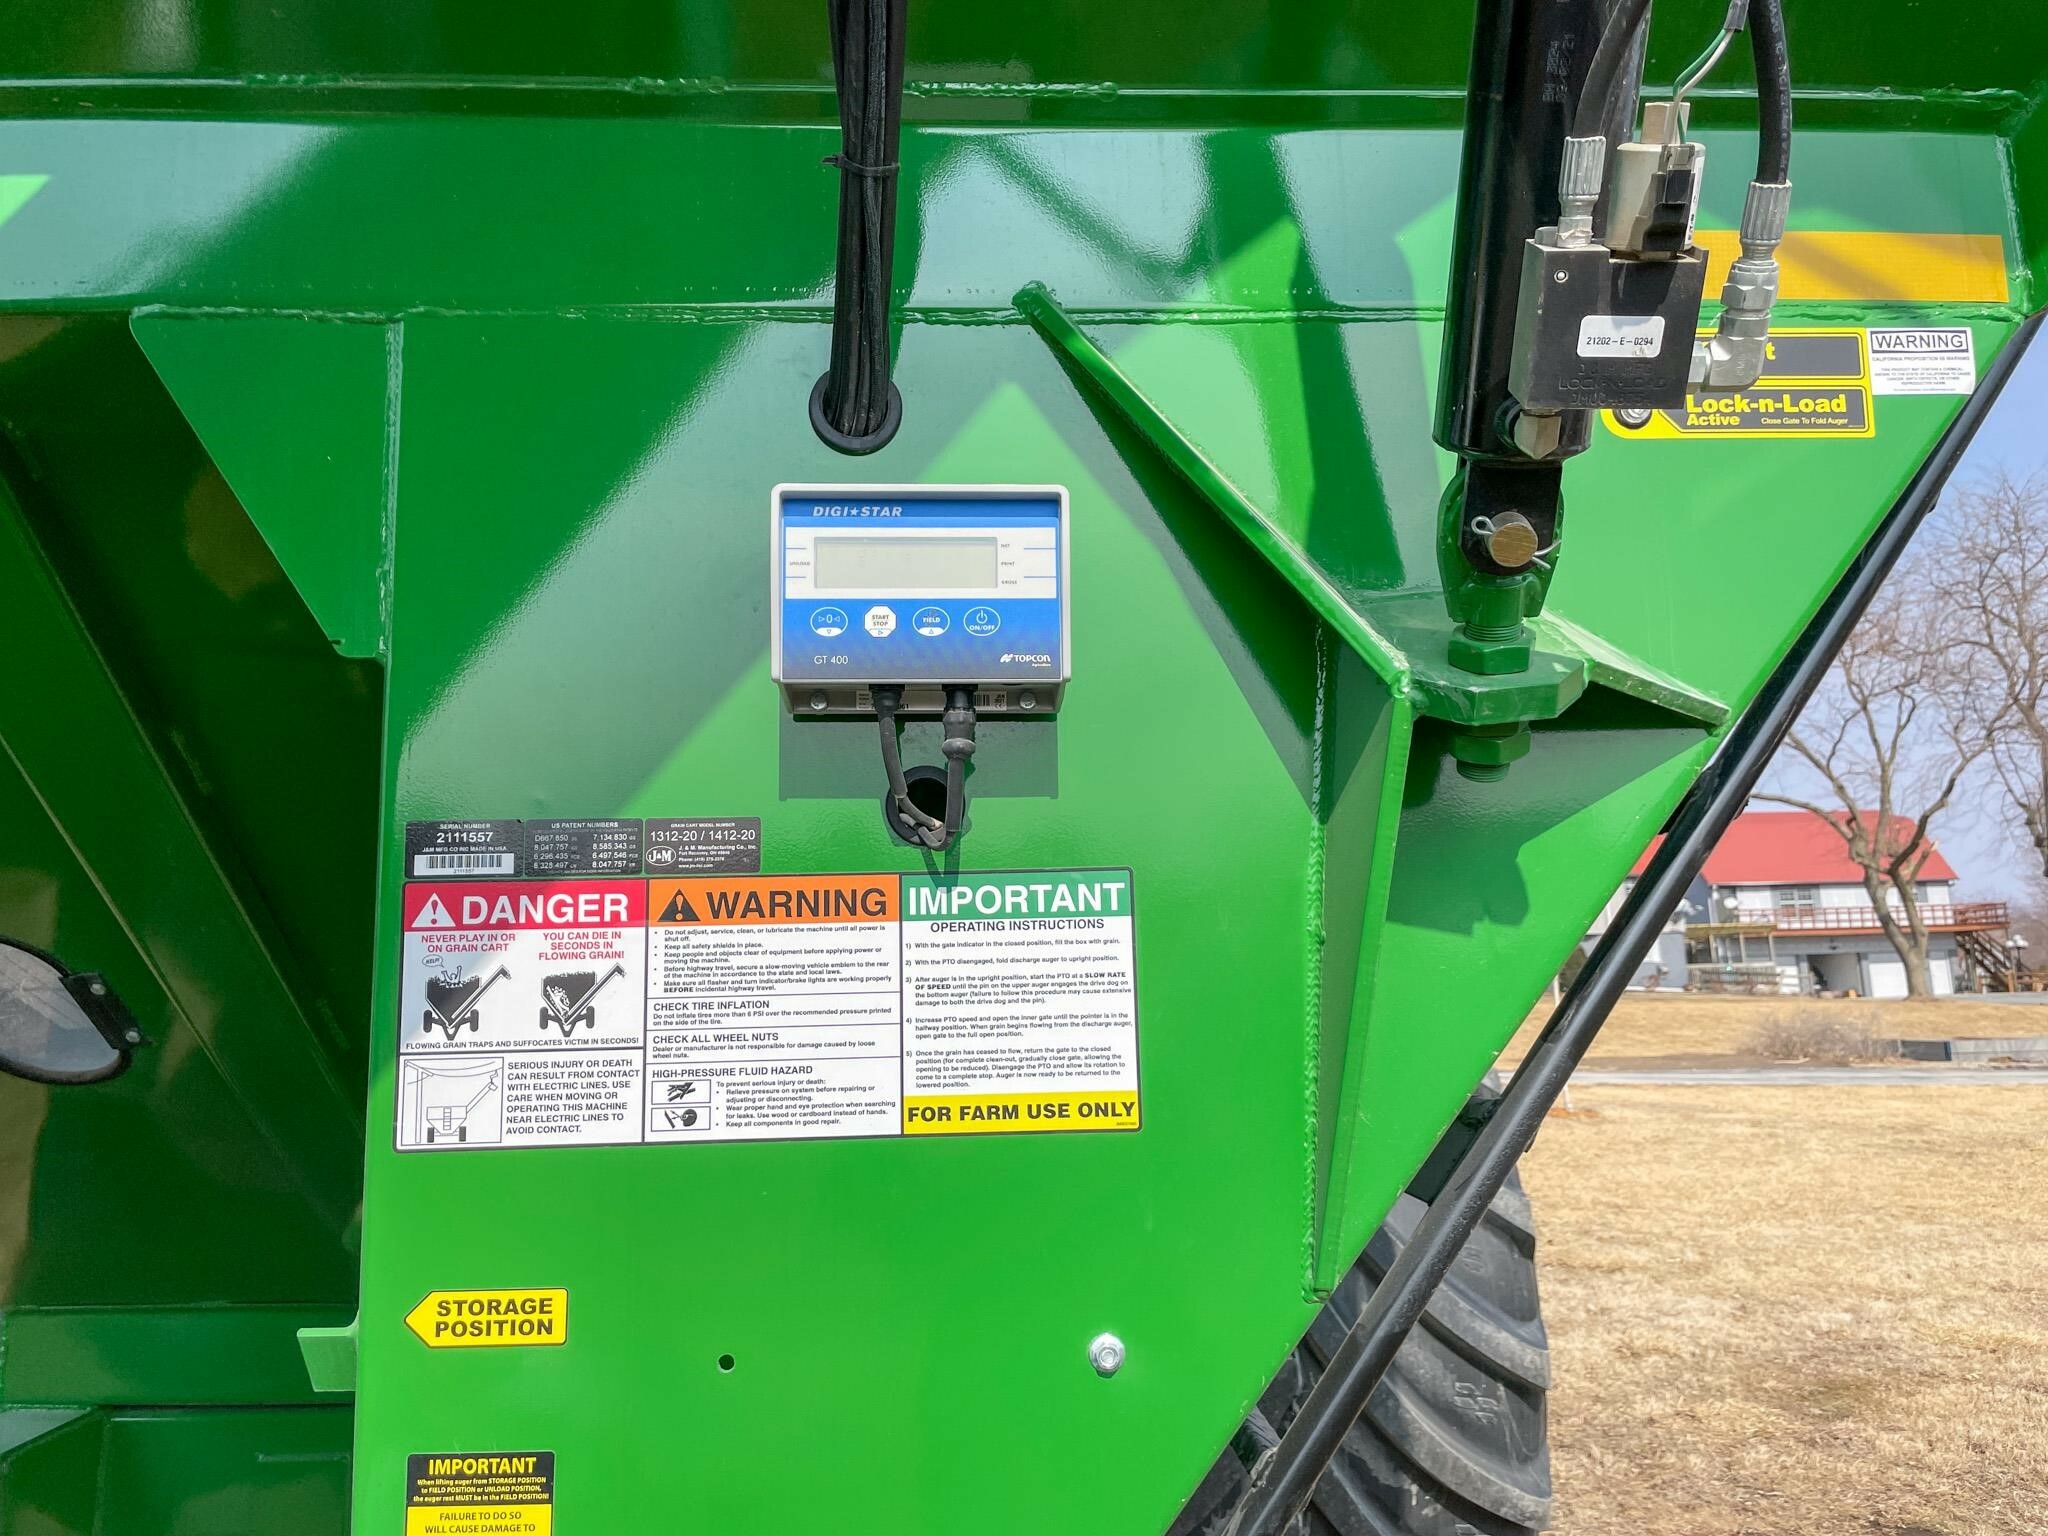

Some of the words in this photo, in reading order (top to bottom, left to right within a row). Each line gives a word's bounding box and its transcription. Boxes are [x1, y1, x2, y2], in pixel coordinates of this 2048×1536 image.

[1875, 334, 1963, 348] WARNING
[1686, 394, 1847, 413] Lock-n-Load
[1686, 413, 1740, 426] Active
[1826, 417, 1850, 426] Auger
[814, 655, 828, 665] GT
[830, 655, 848, 665] 400
[1013, 654, 1051, 662] TOPCON
[436, 831, 494, 843] 2111557
[650, 830, 697, 842] 1312-20
[700, 830, 705, 841] /
[709, 829, 756, 840] 1412-20
[648, 849, 673, 862] J&M
[706, 888, 886, 919] WARNING
[909, 883, 1125, 915] IMPORTANT
[463, 894, 628, 924] DANGER
[928, 918, 1005, 932] OPERATING
[1009, 918, 1104, 931] INSTRUCTIONS
[421, 934, 456, 943] NEVER
[459, 934, 485, 942] PLAY
[487, 933, 498, 942] IN
[500, 933, 515, 942] OR
[543, 932, 565, 941] YOU
[567, 932, 589, 940] CAN
[592, 931, 608, 940] DIE
[611, 931, 622, 939] IN
[427, 944, 443, 953] ON
[445, 944, 478, 953] GRAIN
[480, 943, 509, 952] CART
[550, 941, 600, 951] SECONDS
[603, 941, 613, 949] IN
[538, 951, 586, 961] FLOWING
[588, 950, 624, 960] GRAIN!
[653, 1002, 689, 1012] CHECK
[691, 1001, 715, 1010] TIRE
[717, 1000, 770, 1010] INFLATION
[653, 1035, 689, 1044] CHECK
[690, 1034, 711, 1043] ALL
[713, 1033, 749, 1042] WHEEL
[751, 1032, 779, 1042] NUTS
[404, 1041, 441, 1050] FLOWING
[442, 1040, 467, 1049] GRAIN
[508, 1061, 549, 1070] SERIOUS
[551, 1060, 584, 1069] INJURY
[586, 1060, 600, 1068] OR
[602, 1059, 632, 1067] DEATH
[507, 1072, 527, 1081] CAN
[529, 1071, 566, 1080] RESULT
[567, 1070, 594, 1079] FROM
[596, 1069, 640, 1078] CONTACT
[652, 1068, 736, 1078] HIGH-PRESSURE
[739, 1067, 768, 1076] FLUID
[770, 1065, 813, 1075] HAZARD
[507, 1083, 531, 1091] WITH
[533, 1082, 578, 1091] ELECTRIC
[580, 1081, 610, 1090] LINES.
[612, 1080, 631, 1089] USE
[506, 1094, 533, 1102] CARE
[535, 1093, 563, 1101] WHEN
[565, 1092, 602, 1101] MOVING
[604, 1091, 618, 1100] OR
[506, 1104, 560, 1113] OPERATING
[562, 1103, 583, 1111] THIS
[585, 1102, 628, 1111] MACHINE
[908, 1106, 951, 1122] FOR
[959, 1104, 1019, 1121] FARM
[1027, 1103, 1070, 1119] USE
[1078, 1102, 1135, 1118] ONLY
[506, 1115, 532, 1124] NEAR
[534, 1114, 580, 1123] ELECTRIC
[582, 1113, 609, 1122] LINES
[611, 1112, 624, 1121] TO
[802, 1119, 820, 1127] good
[506, 1126, 534, 1135] AVOID
[536, 1125, 582, 1134] CONTACT.
[437, 1298, 553, 1316] STORAGE
[435, 1319, 553, 1337] POSITION
[429, 1457, 537, 1475] IMPORTANT
[435, 1478, 454, 1486] lifting
[439, 1512, 476, 1521] FAILURE
[478, 1512, 491, 1520] TO
[493, 1511, 507, 1520] DO
[509, 1511, 522, 1520] SO
[425, 1525, 447, 1534] WILL
[449, 1524, 479, 1534] CAUSE
[481, 1524, 521, 1533] DAMAGE
[523, 1523, 536, 1532] TO
